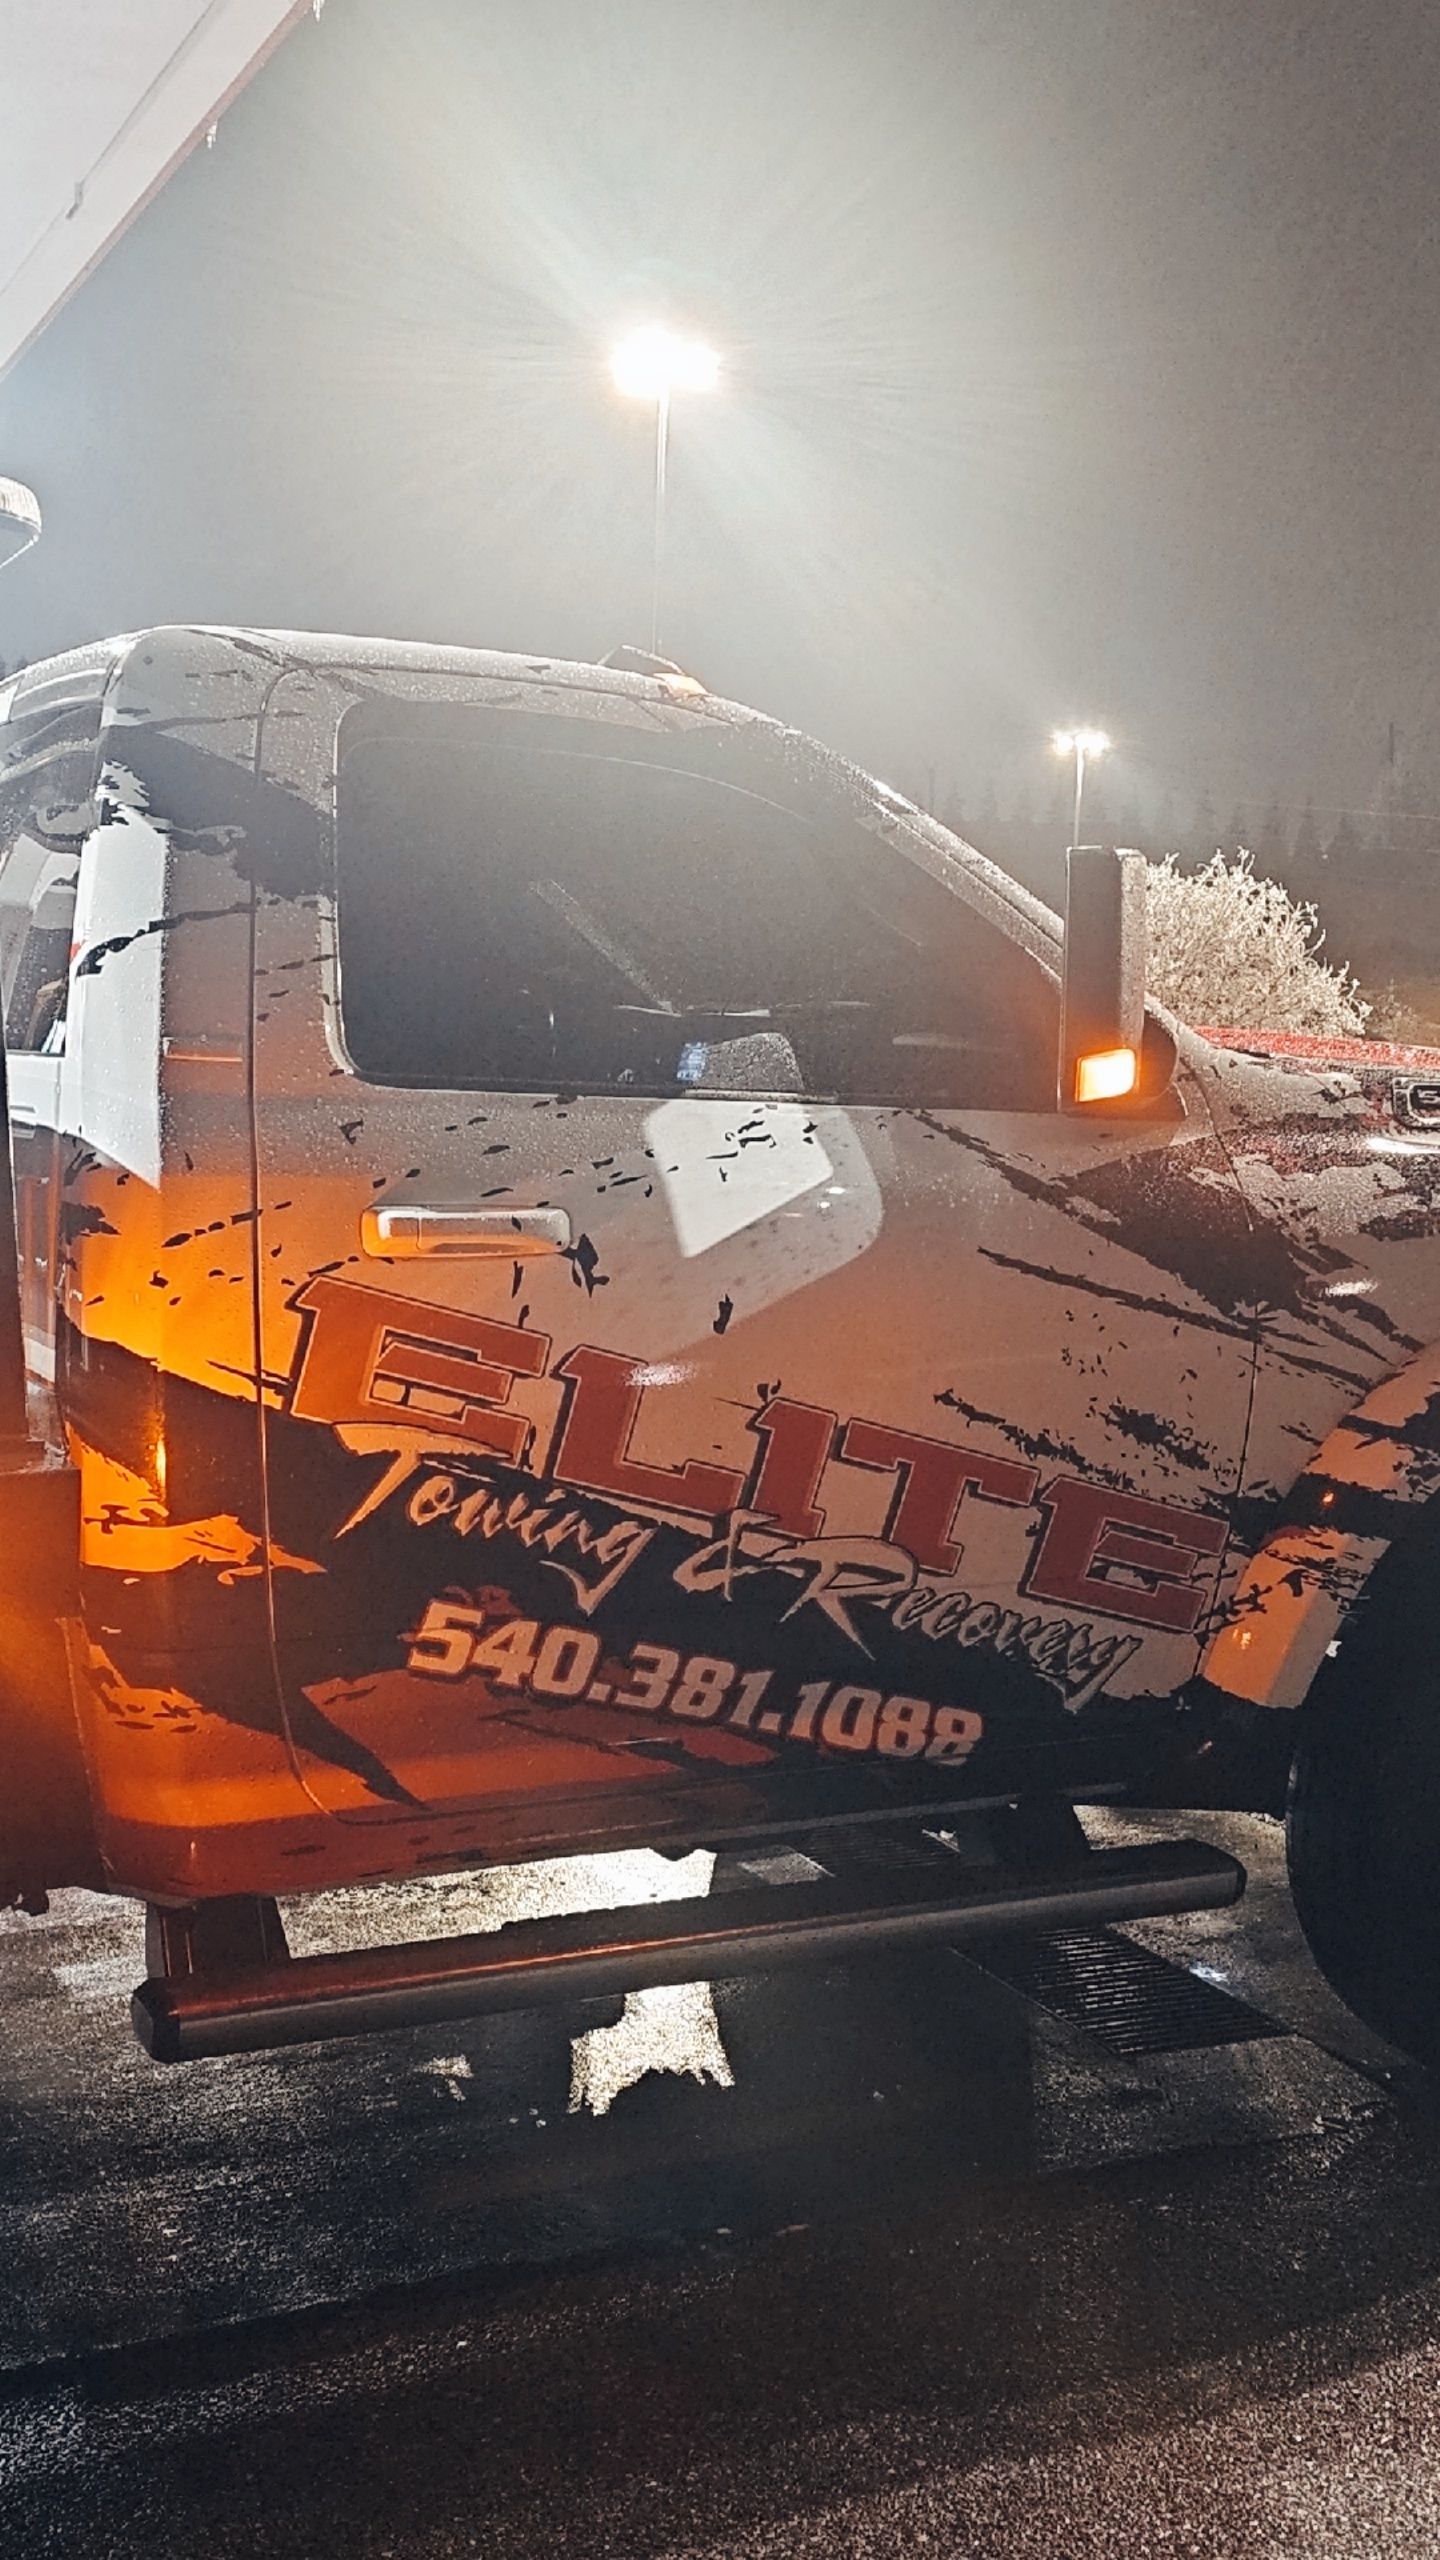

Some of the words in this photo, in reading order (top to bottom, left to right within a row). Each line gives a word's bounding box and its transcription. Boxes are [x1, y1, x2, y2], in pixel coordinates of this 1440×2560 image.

[290, 1275, 1230, 1635] ELITE
[333, 1423, 656, 1616] Towing
[673, 1509, 806, 1602] &
[757, 1534, 1143, 1714] Recovery
[405, 1598, 984, 1766] 540.381.1088
